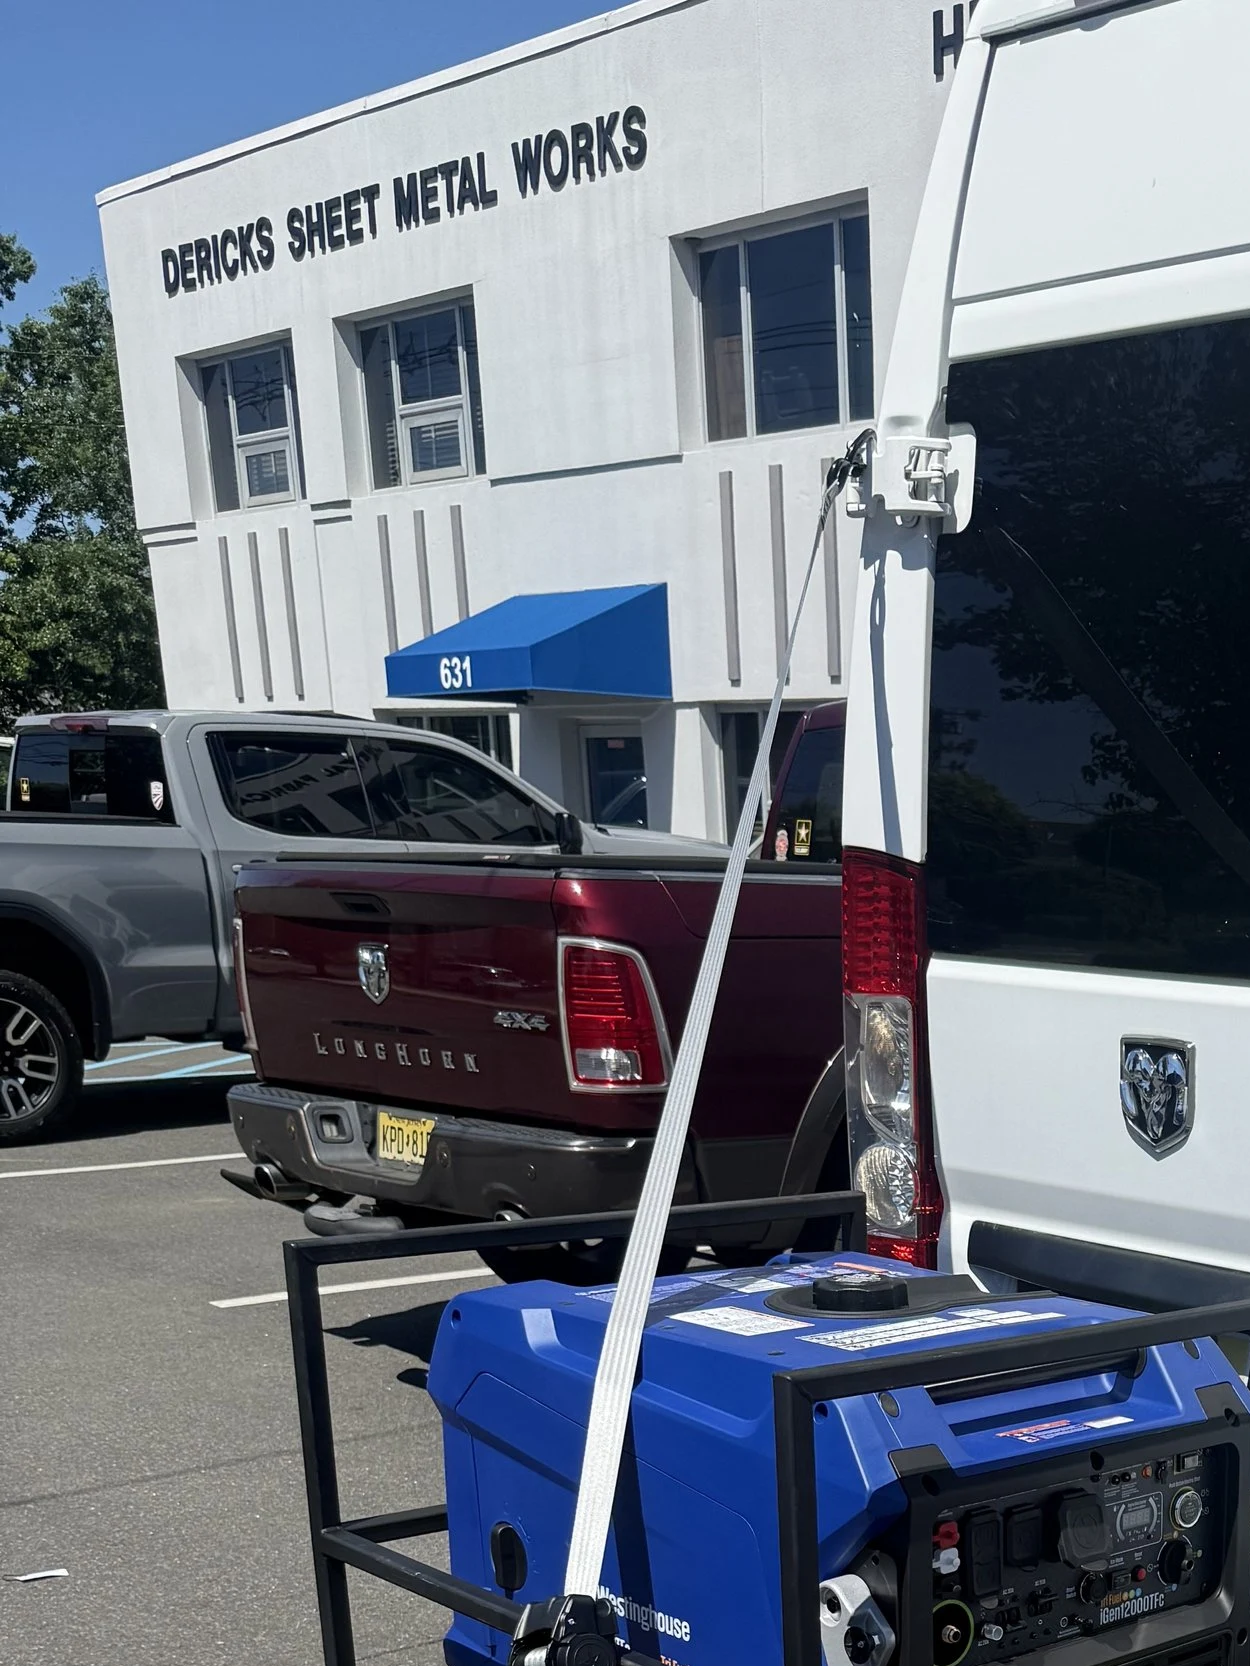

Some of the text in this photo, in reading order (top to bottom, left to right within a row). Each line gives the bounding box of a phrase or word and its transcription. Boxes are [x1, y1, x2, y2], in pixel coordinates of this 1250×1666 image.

[161, 105, 648, 298] DERICKS SHEET METAL WORKS
[439, 655, 473, 690] 631
[382, 1124, 404, 1155] KPD
